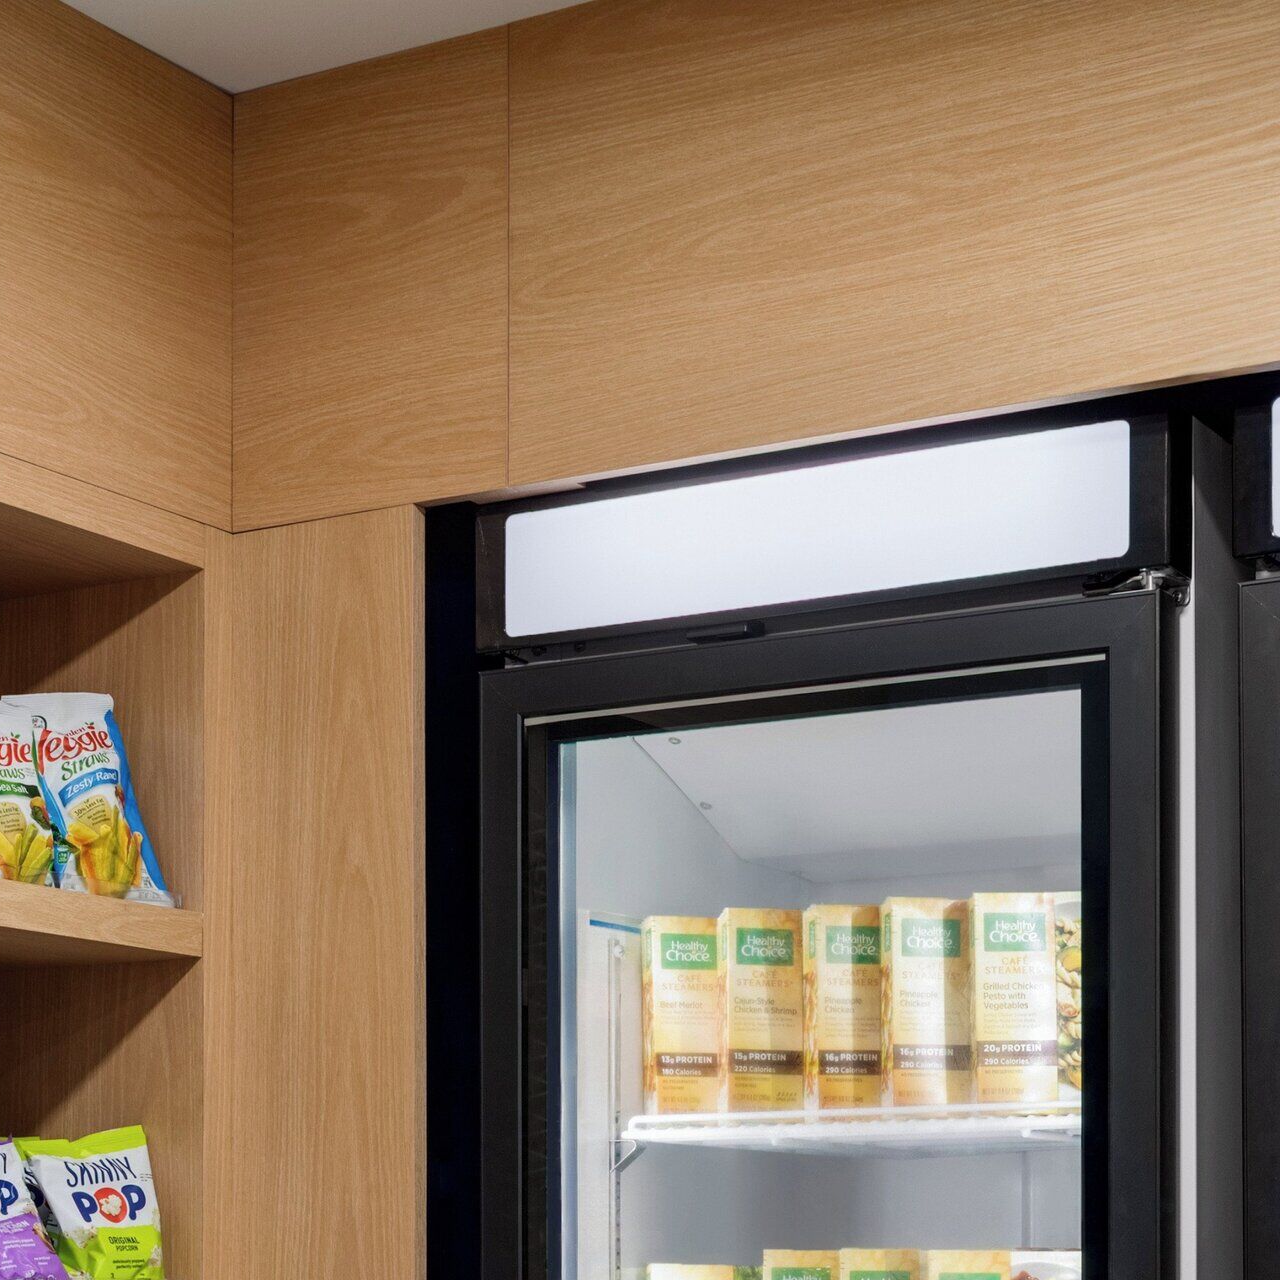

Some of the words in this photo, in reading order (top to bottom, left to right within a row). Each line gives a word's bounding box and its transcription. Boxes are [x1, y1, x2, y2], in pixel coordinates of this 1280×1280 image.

[37, 728, 112, 775] Veggie
[62, 752, 110, 781] Straws
[12, 784, 28, 794] Salt
[66, 776, 93, 798] Zesty
[996, 920, 1036, 933] Healthy
[989, 931, 1038, 943] Choice
[742, 944, 786, 957] Choice
[1002, 1044, 1041, 1052] PROTEIN
[66, 1156, 136, 1188] SKINNY
[71, 1184, 146, 1223] POP
[109, 1236, 139, 1244] ORIGINAL
